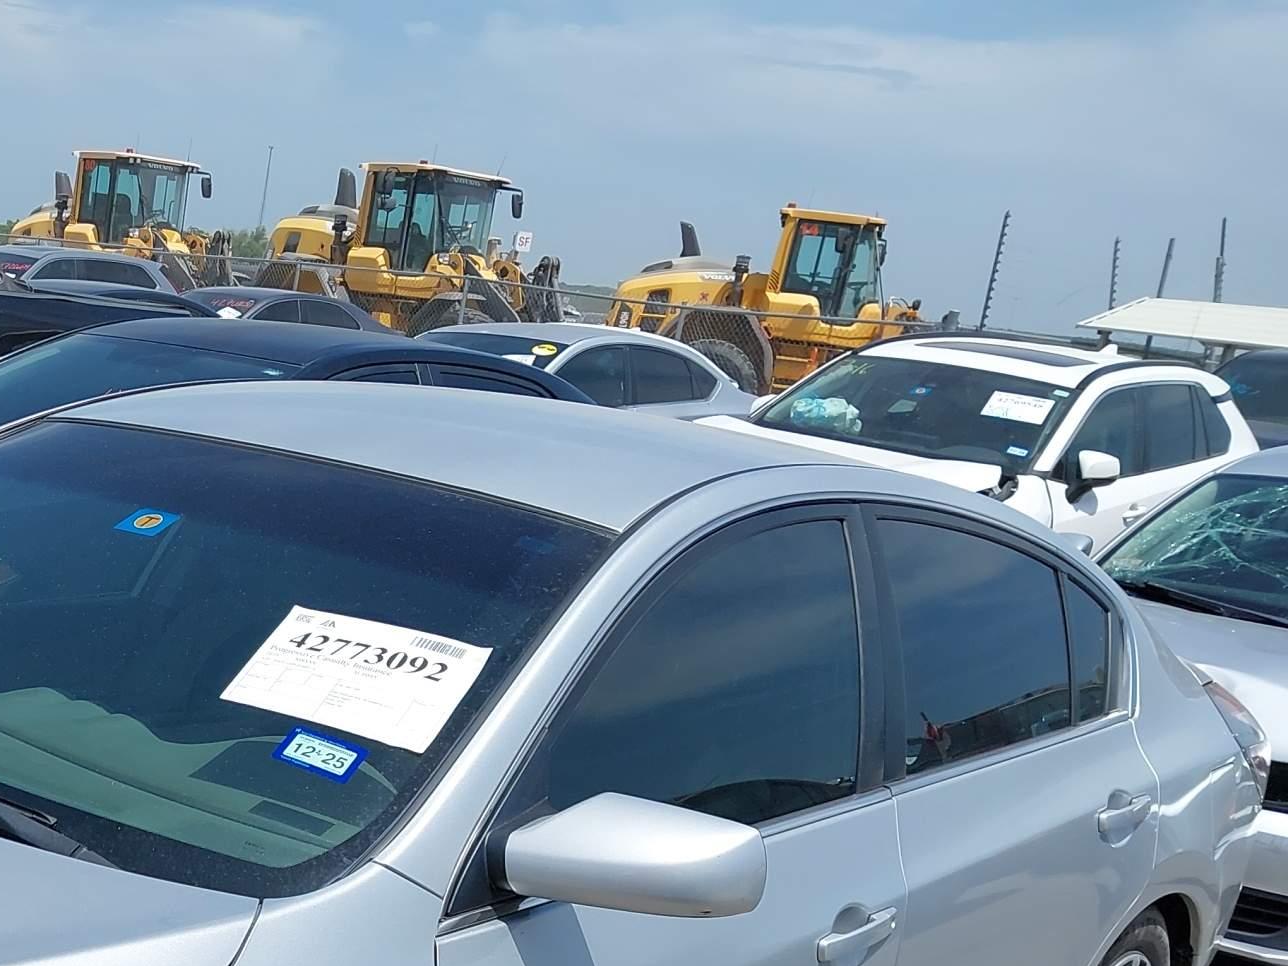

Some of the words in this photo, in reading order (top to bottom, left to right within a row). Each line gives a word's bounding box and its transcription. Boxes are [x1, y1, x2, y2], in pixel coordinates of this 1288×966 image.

[518, 236, 530, 247] SF
[141, 516, 160, 526] T
[289, 632, 448, 682] 42773092
[293, 742, 316, 758] 12
[321, 752, 348, 769] 25
